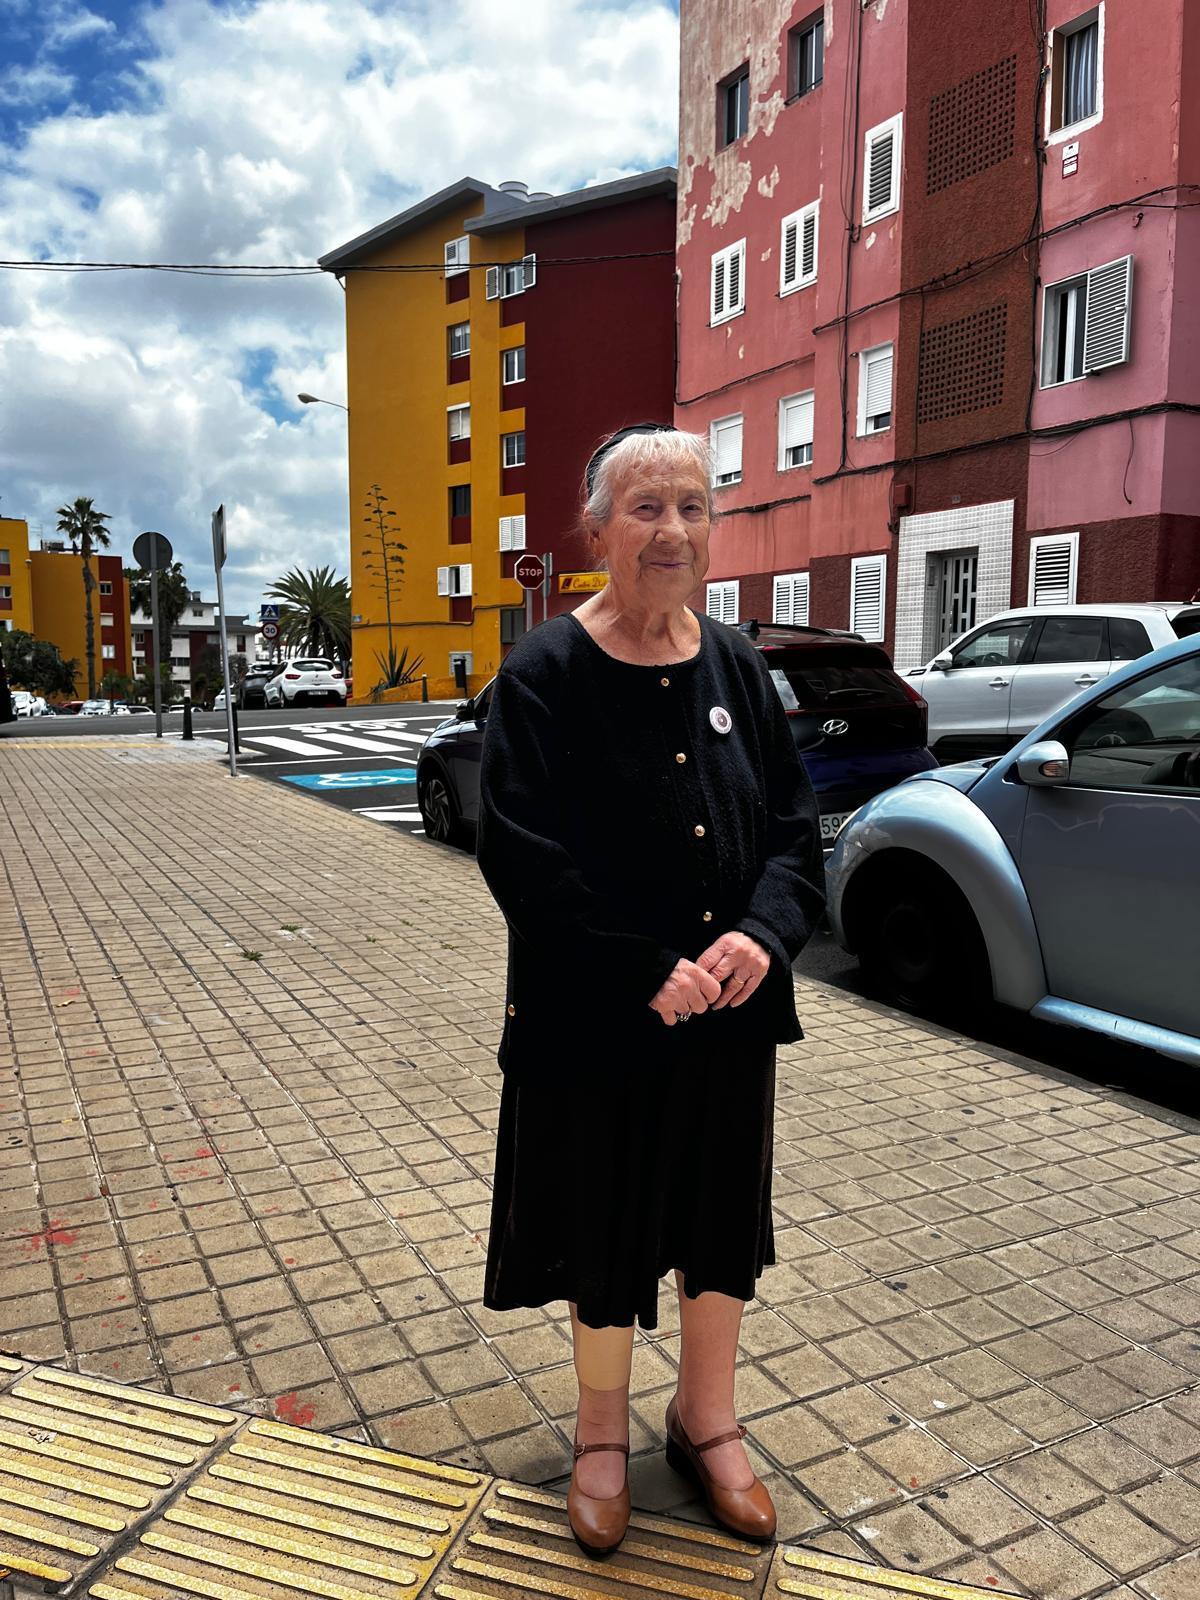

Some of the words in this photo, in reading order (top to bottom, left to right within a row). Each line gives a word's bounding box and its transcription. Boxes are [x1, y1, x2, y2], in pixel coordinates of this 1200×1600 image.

[518, 567, 543, 577] STOP
[264, 626, 276, 634] 30
[289, 721, 408, 734] STOP
